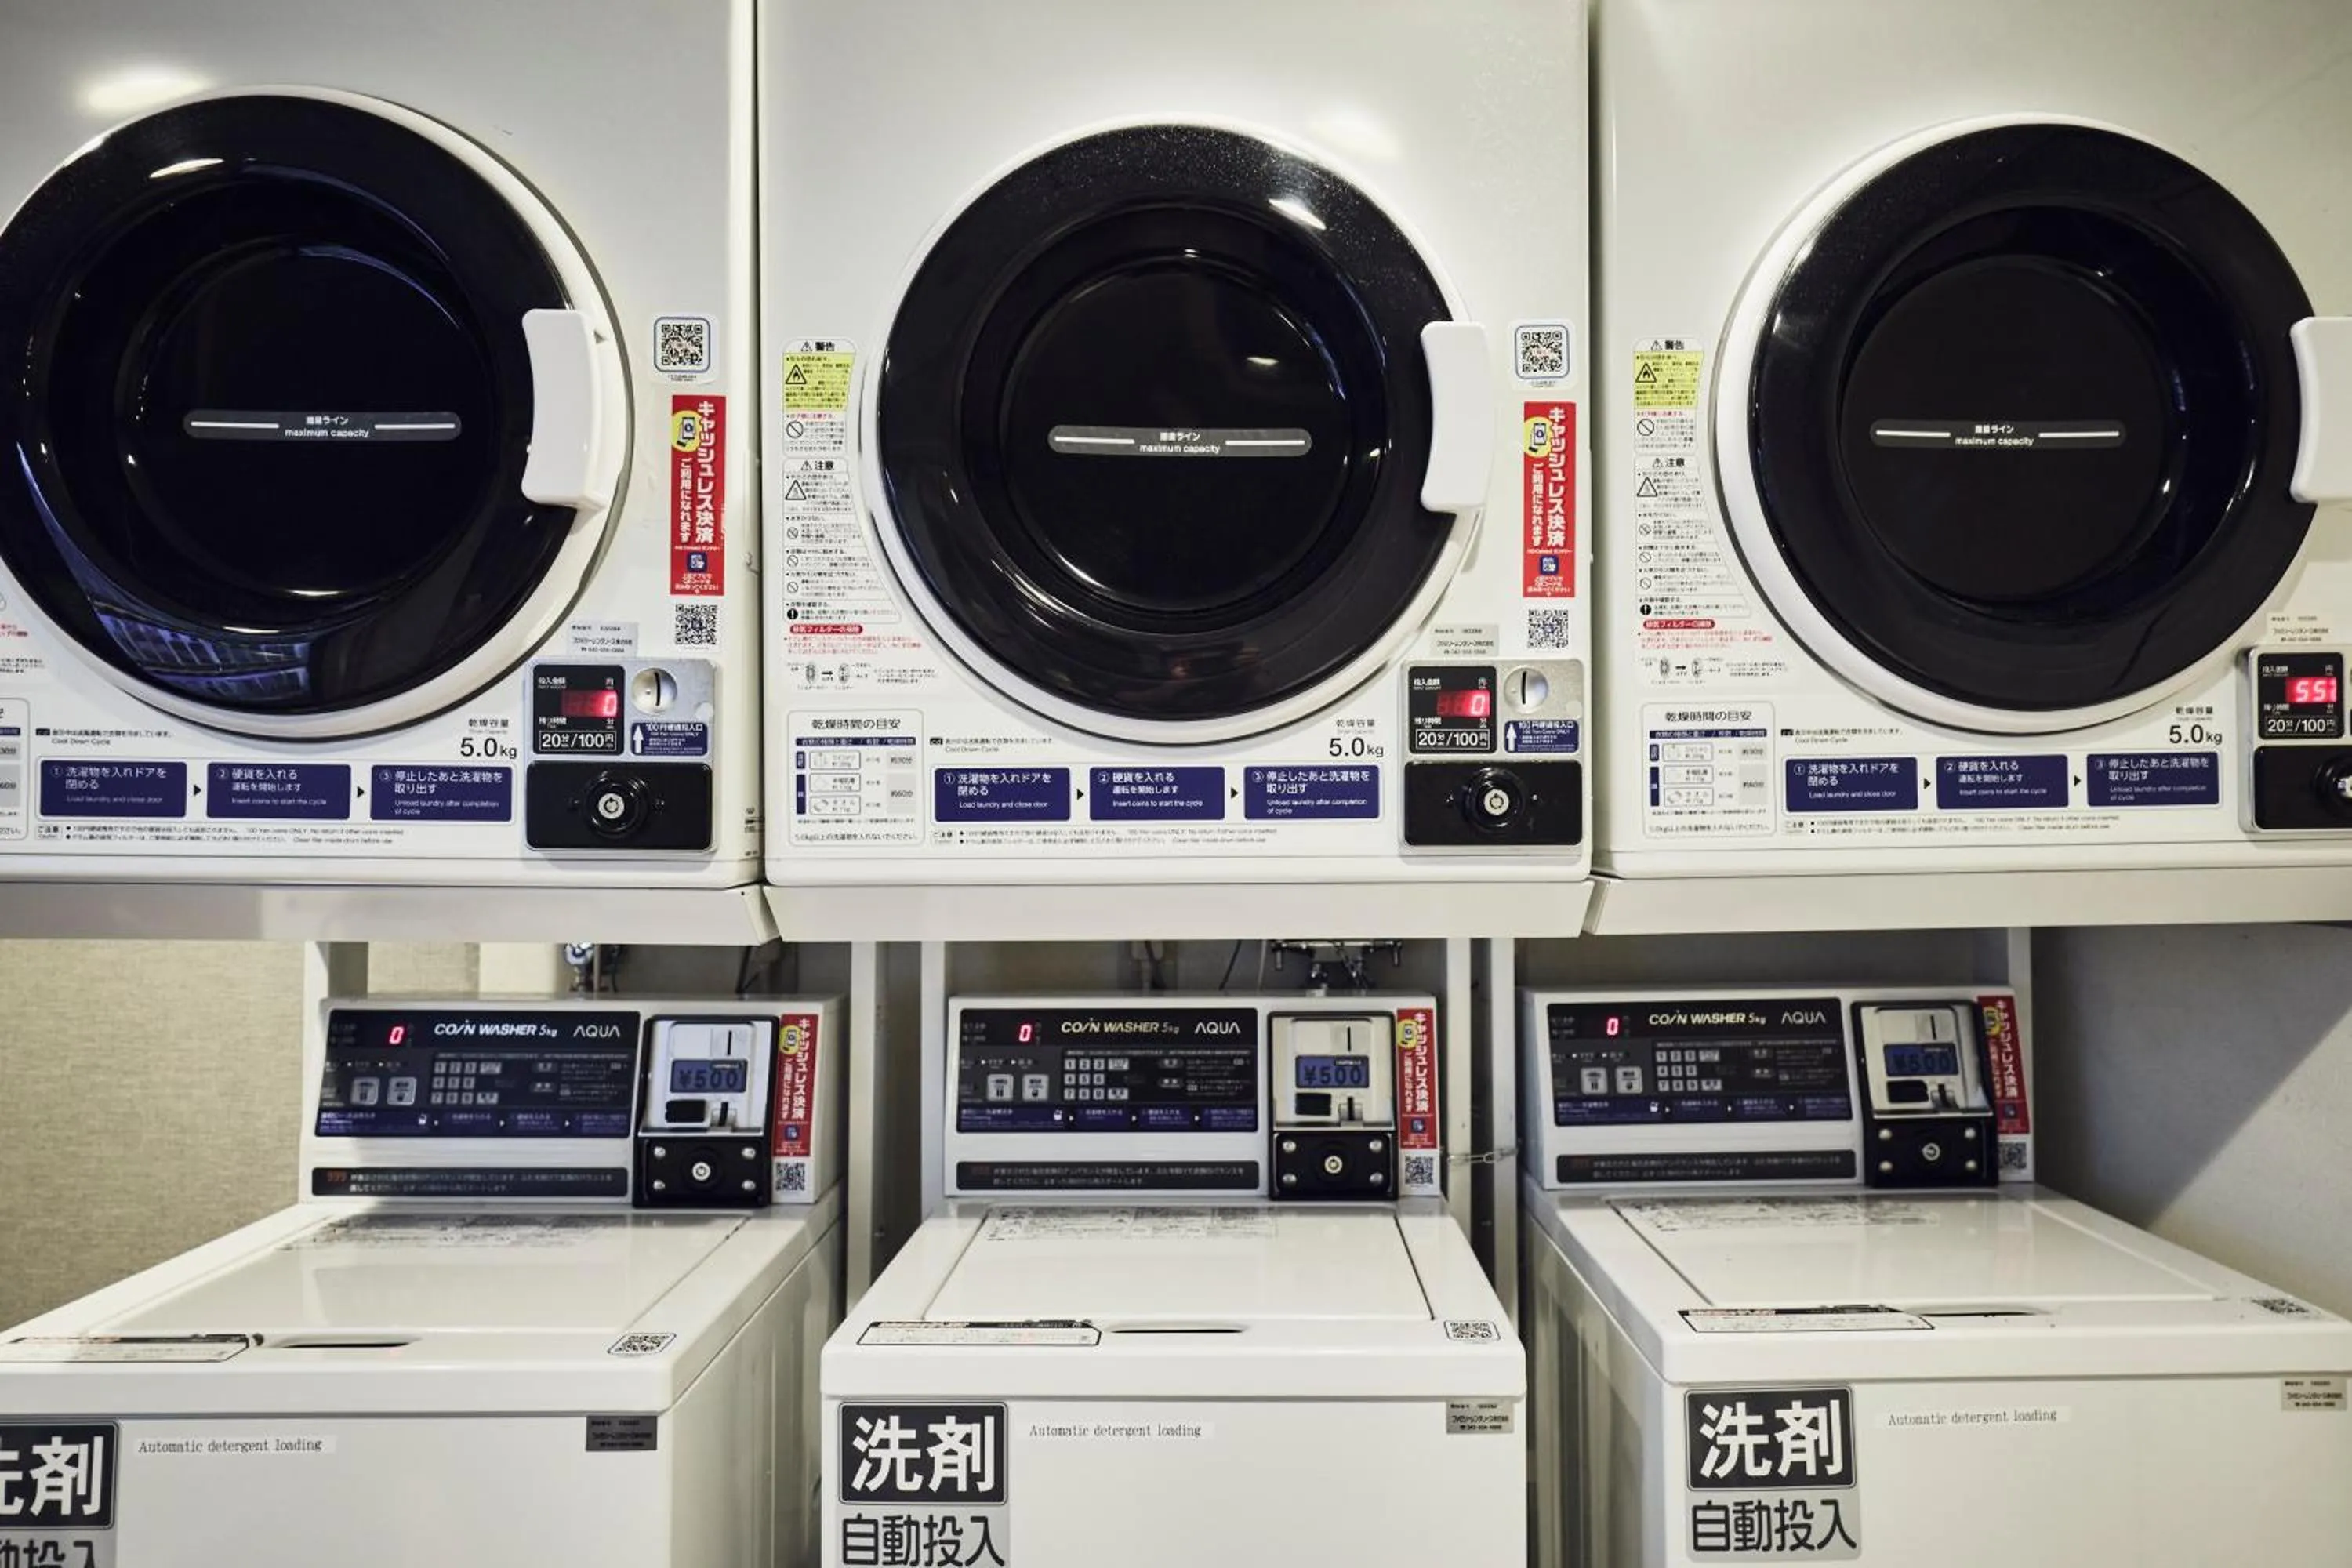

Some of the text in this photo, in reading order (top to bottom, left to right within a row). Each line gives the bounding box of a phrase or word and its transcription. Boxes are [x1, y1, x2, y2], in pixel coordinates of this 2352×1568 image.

[285, 428, 370, 438] maximum capacity
[1955, 437, 2034, 447] maximum capacity
[1139, 444, 1221, 454] maximum capacity
[697, 401, 716, 543] キャッシュレス決済
[1548, 407, 1566, 547] キャッシュレス決済
[603, 692, 618, 717] 0
[1471, 693, 1486, 716] 0
[1665, 711, 1753, 722] 乾燥時間の目安
[811, 719, 901, 730] 乾燥時間の目安
[1808, 762, 1900, 775] 洗濯物を入れドアを
[1958, 760, 2020, 772] 硬貨を入れる
[2108, 757, 2209, 770] 停止したあと洗濯物を
[65, 766, 167, 779] 洗濯物を入れドアを
[231, 768, 298, 779] 硬貨を入れる
[394, 770, 503, 783] 停止したあと洗濯物を
[957, 771, 1051, 785] 洗濯物を入れドアを
[1112, 771, 1175, 783] 硬貨を入れる
[1266, 770, 1370, 782] 停止したあと洗濯物を
[1958, 774, 2024, 784] 運転を開始します
[2108, 771, 2148, 781] 取り出す
[65, 779, 100, 790] 閉める
[232, 782, 302, 792] 運転を開始します
[1808, 775, 1838, 786] 閉める
[394, 783, 437, 794] 取り出す
[957, 786, 989, 797] 閉める
[1112, 786, 1179, 795] 運転を開始します
[1266, 783, 1307, 794] 取り出す
[959, 800, 976, 809] Load
[1112, 799, 1131, 808] Insert
[1131, 799, 1149, 808] coins
[1150, 799, 1156, 808] to
[1174, 799, 1184, 808] the
[1185, 799, 1203, 808] cycle
[1275, 807, 1293, 815] cycle
[1690, 1013, 1746, 1024] WASHER
[1781, 1011, 1827, 1024] AQUA
[479, 1023, 537, 1036] WASHER
[573, 1025, 621, 1037] AQUA
[1018, 1025, 1032, 1042] 0
[1104, 1022, 1160, 1033] WASHER
[1195, 1022, 1241, 1034] AQUA
[1606, 1018, 1619, 1036] 0
[389, 1026, 404, 1044] 0
[1414, 1012, 1429, 1112] キャッシュレス決済
[790, 1018, 811, 1120] キャッシュレス決済
[1304, 1066, 1362, 1084] ¥500
[679, 1069, 739, 1088] ¥500
[1888, 1409, 2058, 1426] Automatic detergent loading
[1029, 1424, 1202, 1439] Automatic detergent loading
[1699, 1399, 1844, 1478] 洗剤
[138, 1438, 323, 1454] Automatic detergent loading
[851, 1415, 996, 1492] 洗剤
[1691, 1499, 1857, 1552] 自動投入
[842, 1513, 1005, 1567] 自動投入
